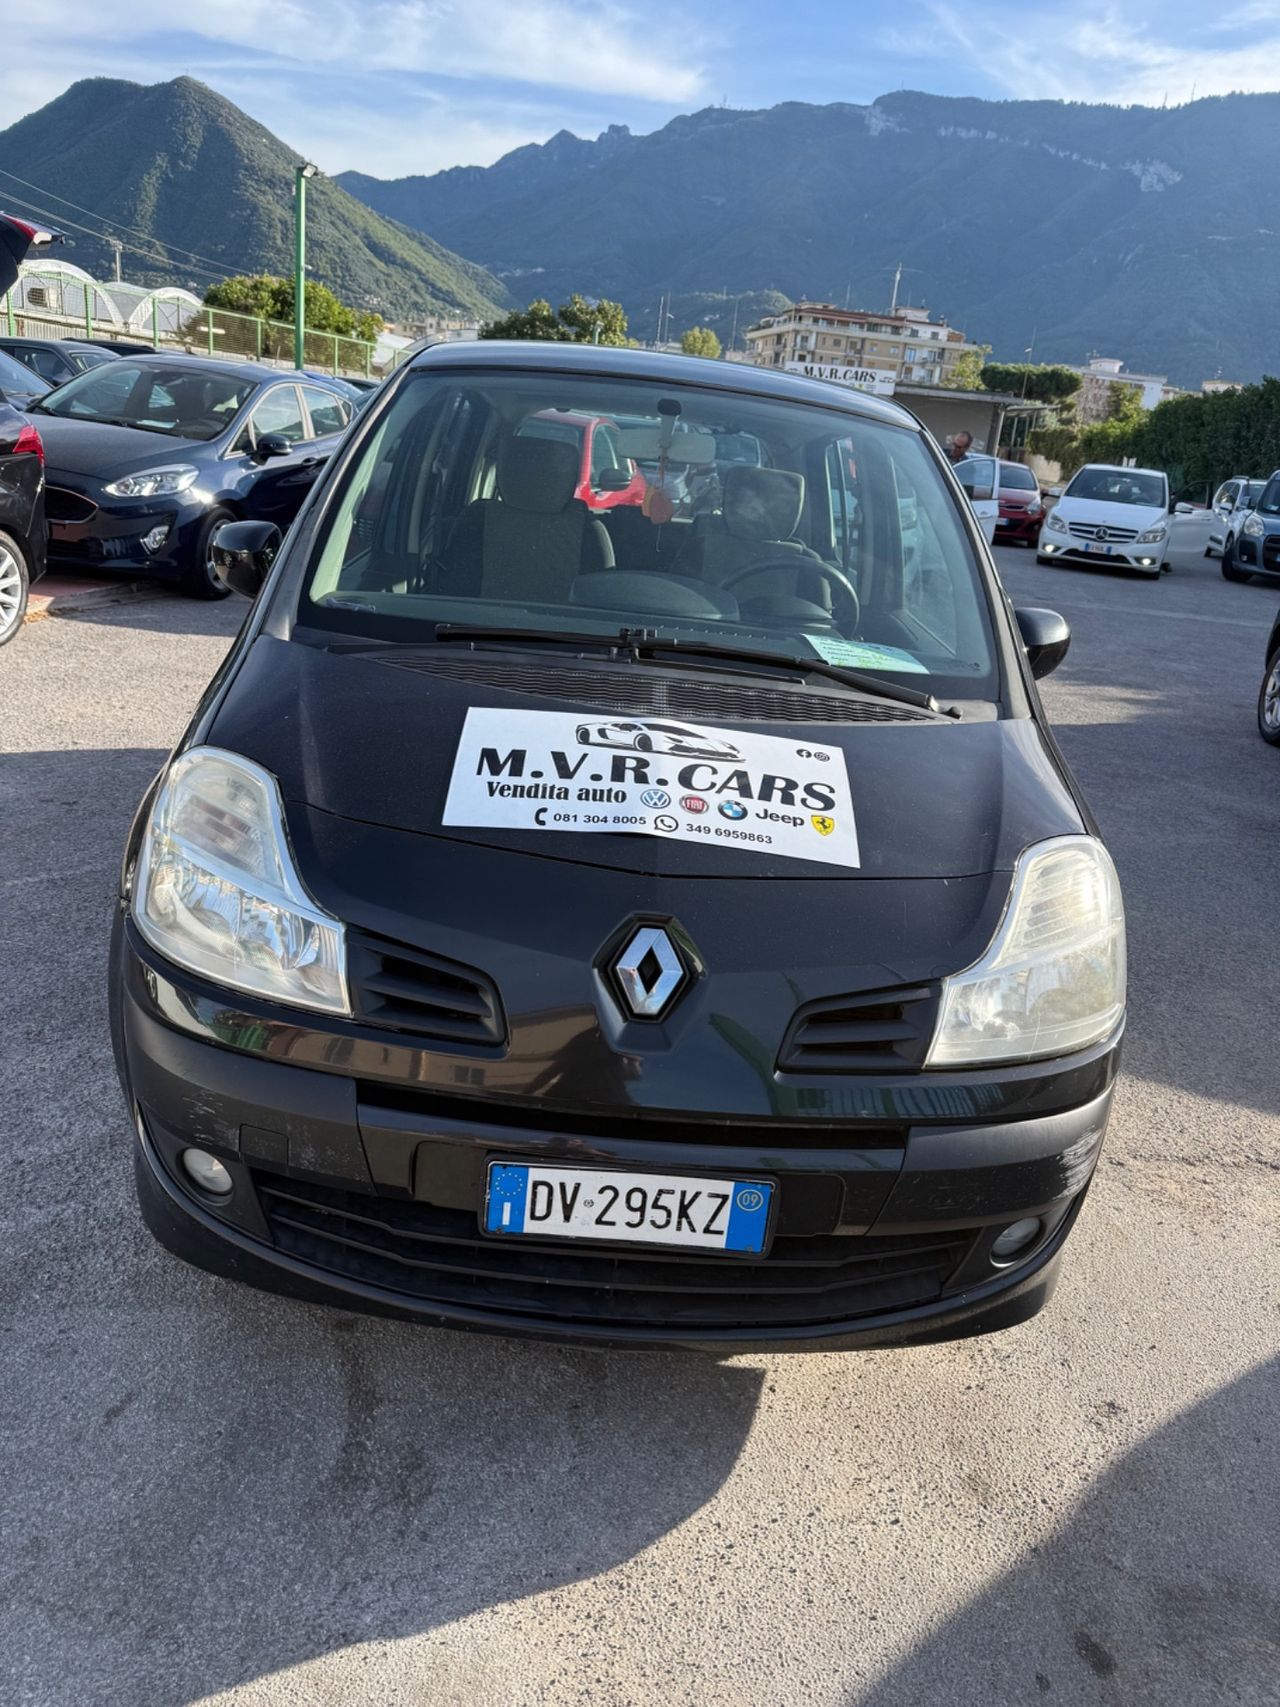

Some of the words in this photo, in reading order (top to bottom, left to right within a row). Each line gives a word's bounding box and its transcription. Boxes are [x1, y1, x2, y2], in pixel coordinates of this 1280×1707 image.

[487, 781, 569, 801] Vendita
[577, 787, 627, 804] auto
[554, 813, 578, 823] 081
[583, 814, 608, 824] 304
[613, 815, 647, 825] 8005
[755, 808, 805, 827] Jeep
[686, 823, 711, 835] 349
[715, 826, 773, 844] 6959863
[742, 1194, 757, 1207] 09
